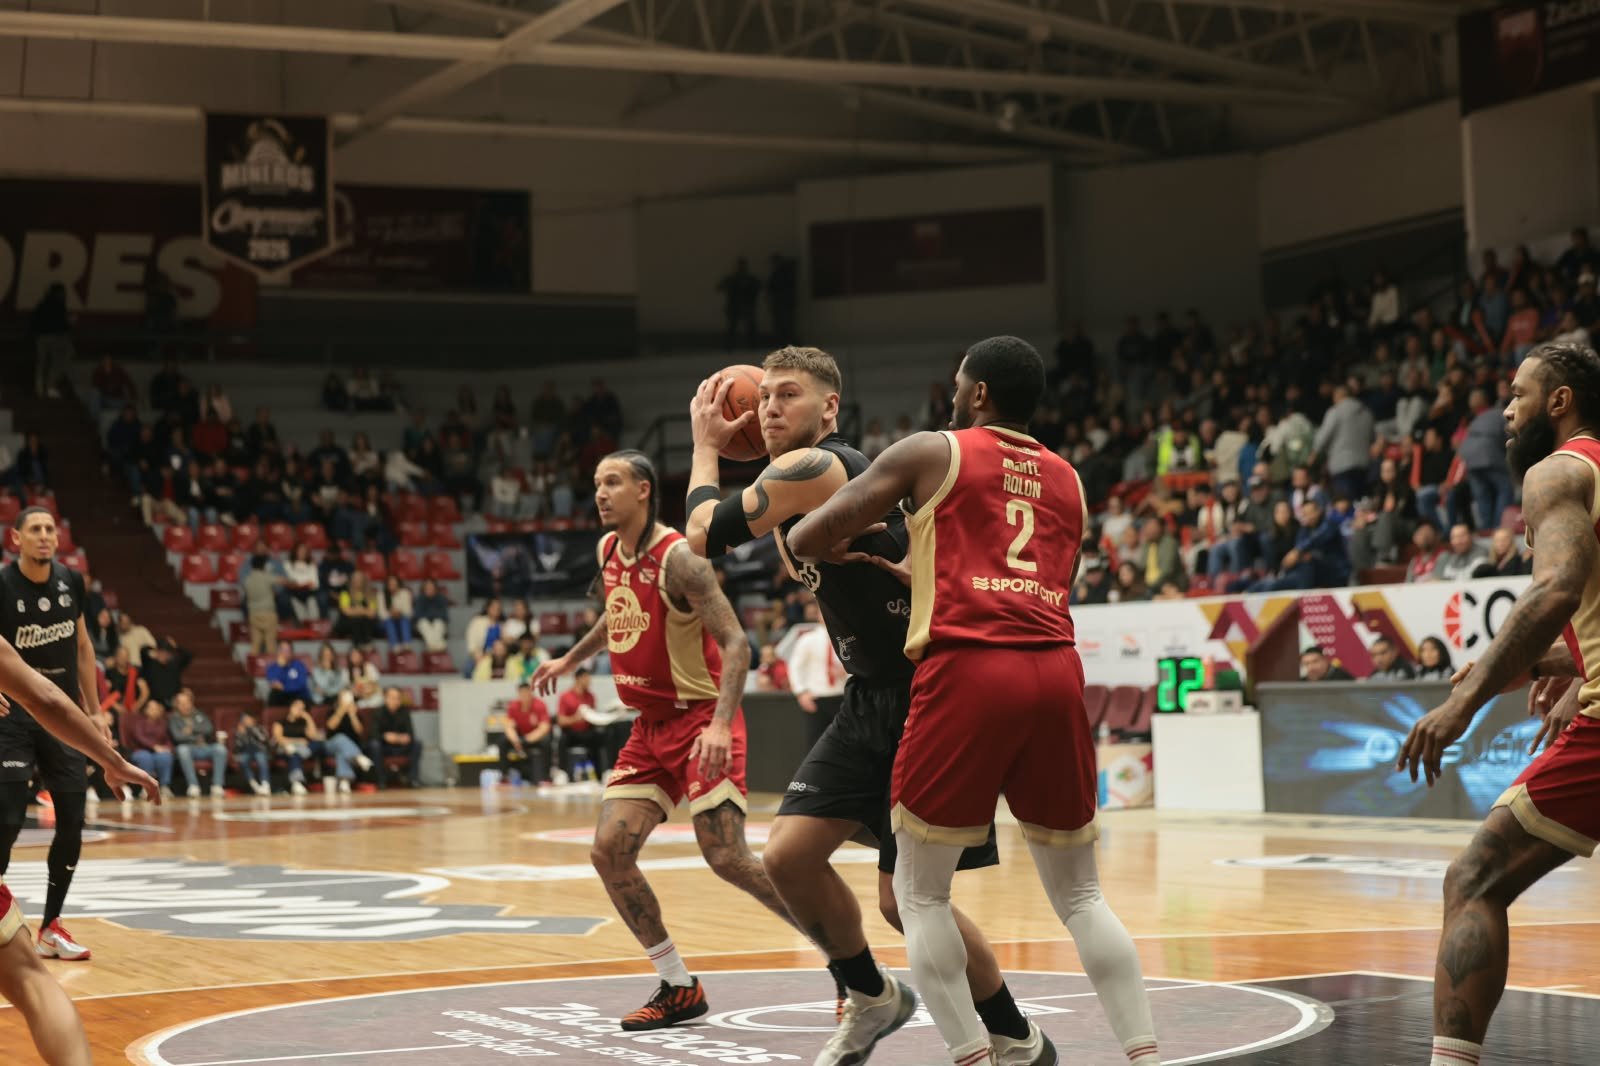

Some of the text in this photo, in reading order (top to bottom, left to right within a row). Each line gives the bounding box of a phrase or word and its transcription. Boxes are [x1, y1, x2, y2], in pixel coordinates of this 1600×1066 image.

[0, 231, 222, 320] RES
[1003, 473, 1041, 499] ROLON
[1006, 498, 1037, 572] 2
[441, 1010, 560, 1037] GOBIERNO
[540, 1035, 604, 1049] DEL
